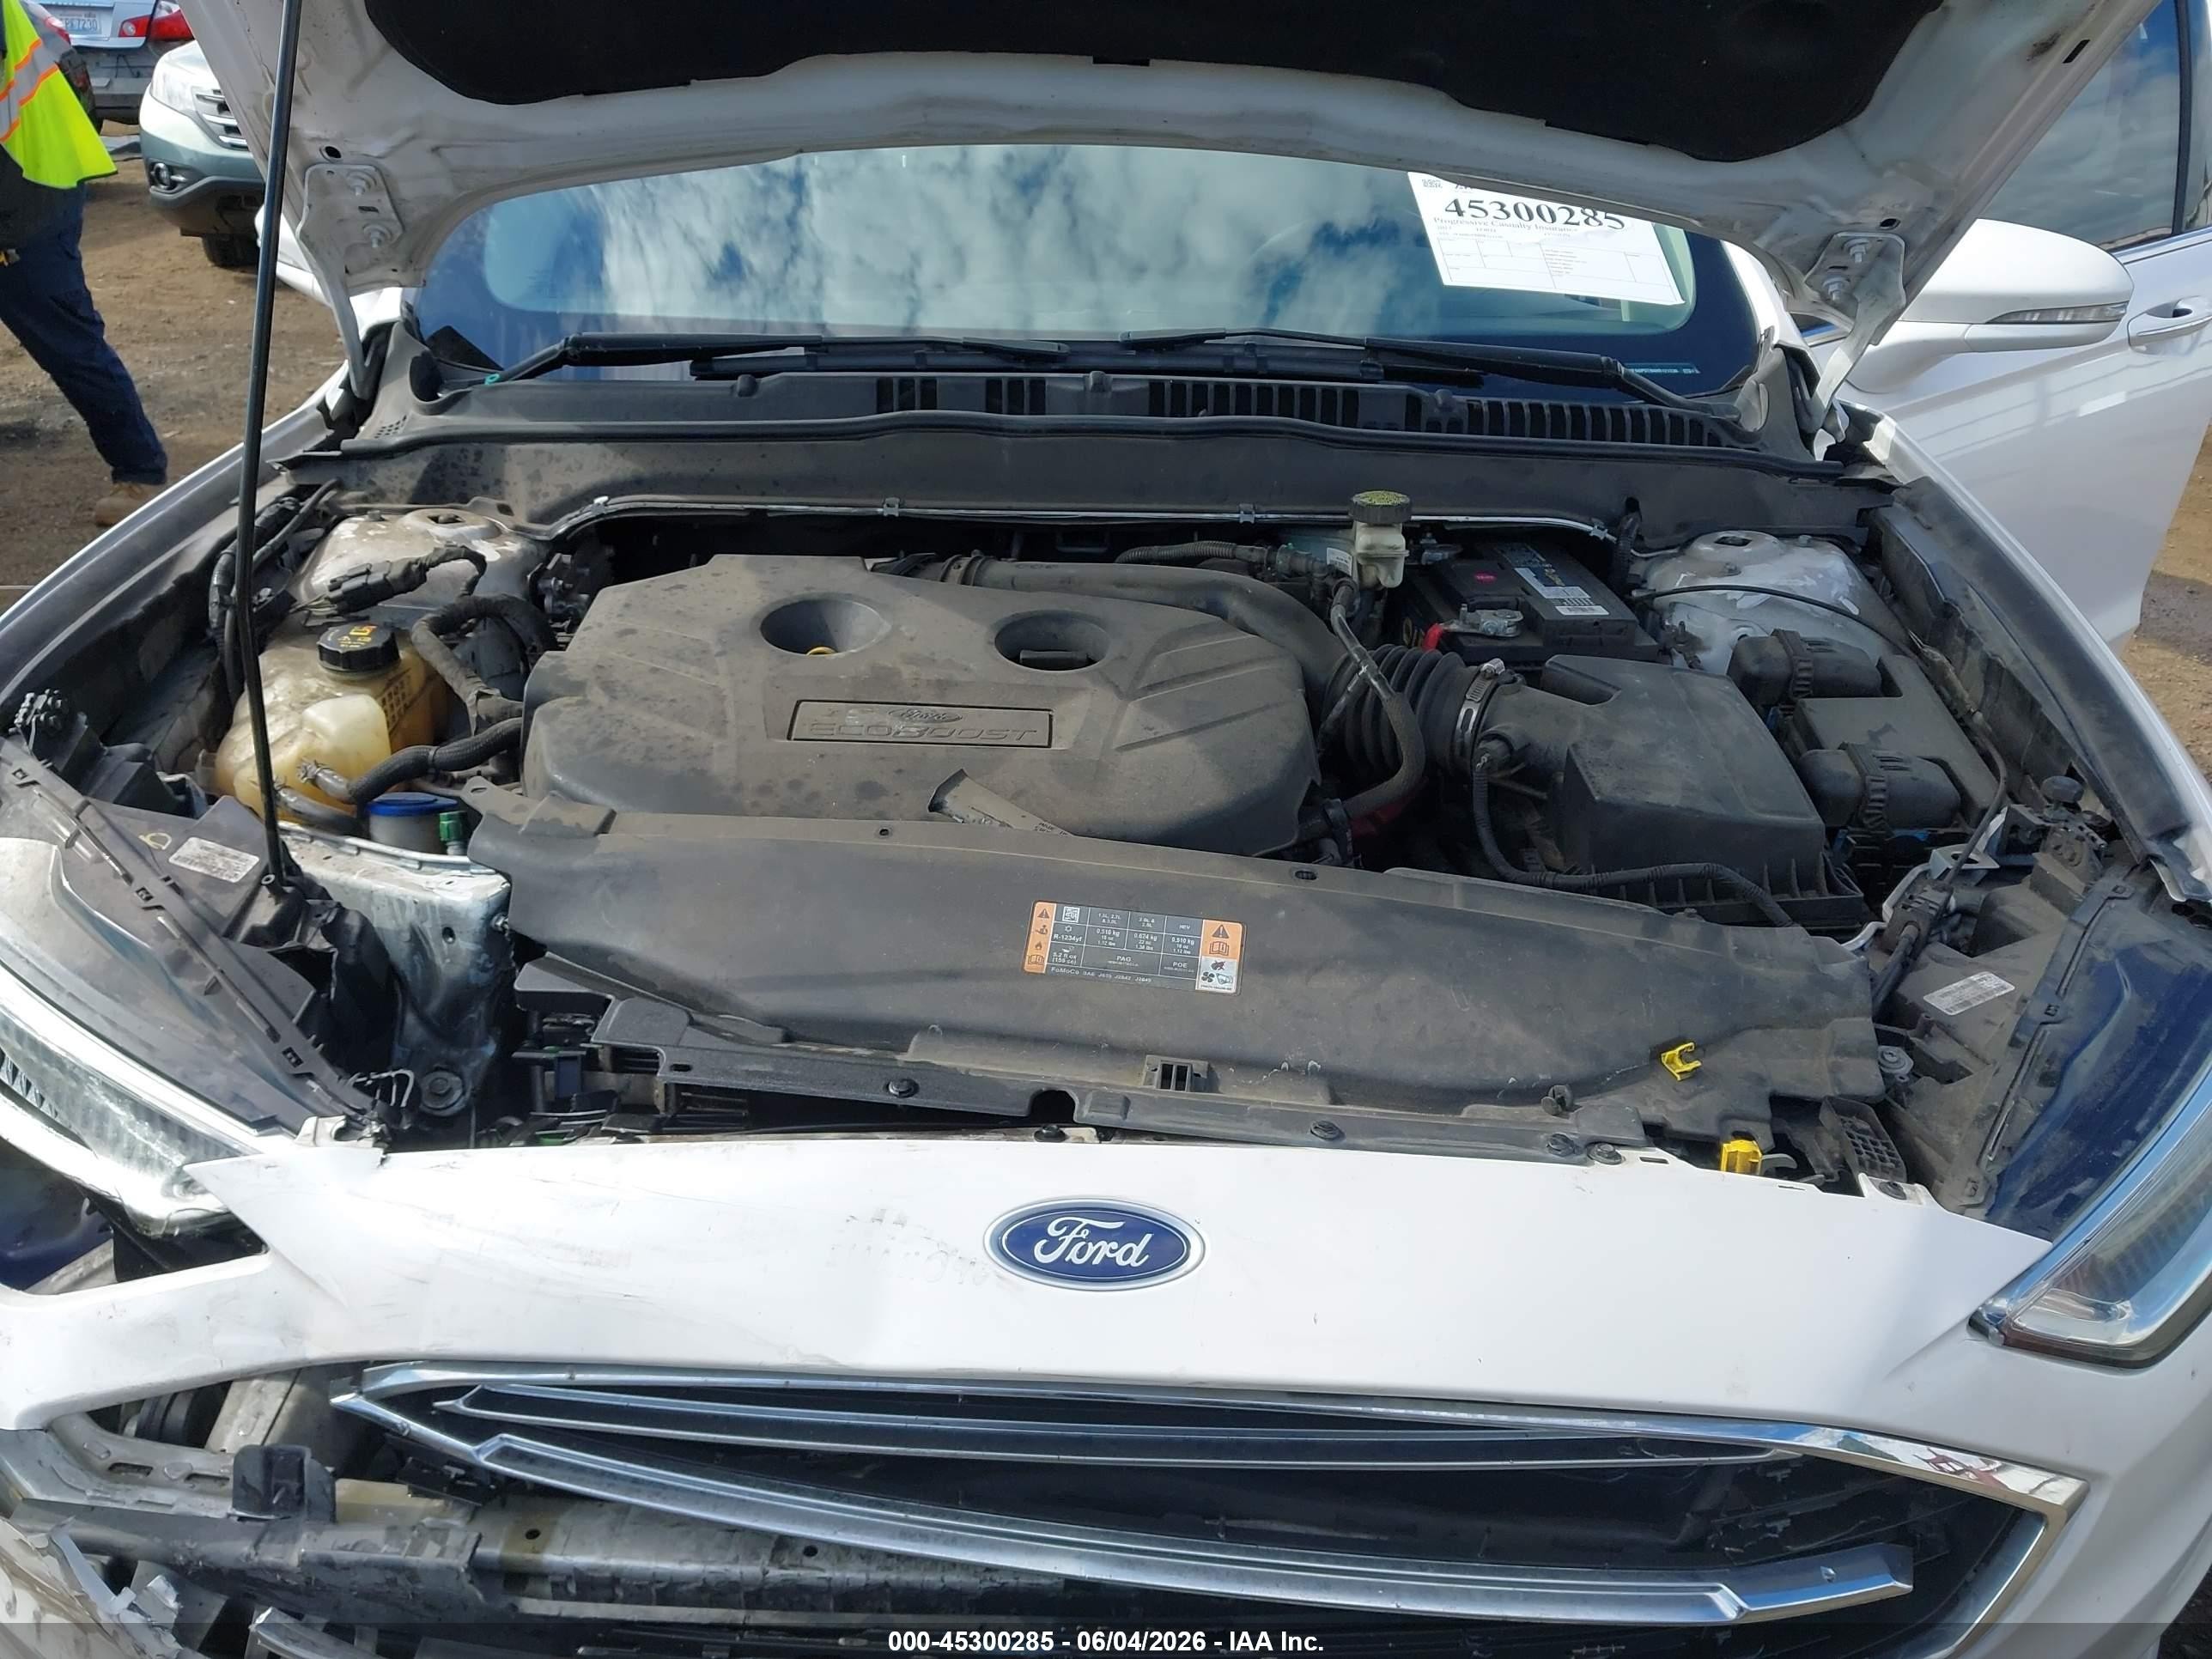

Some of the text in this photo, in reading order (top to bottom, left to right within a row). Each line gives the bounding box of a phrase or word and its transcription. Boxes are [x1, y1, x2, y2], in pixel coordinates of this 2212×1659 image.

[1445, 198, 1626, 230] 45300285
[1433, 216, 1489, 227] Progressive
[1491, 219, 1532, 231] Casualty
[811, 722, 1037, 741] ECOBOOST
[1053, 933, 1083, 943] R-1234yf
[1050, 967, 1079, 975] FoMoCo
[1033, 1216, 1155, 1267] Ford
